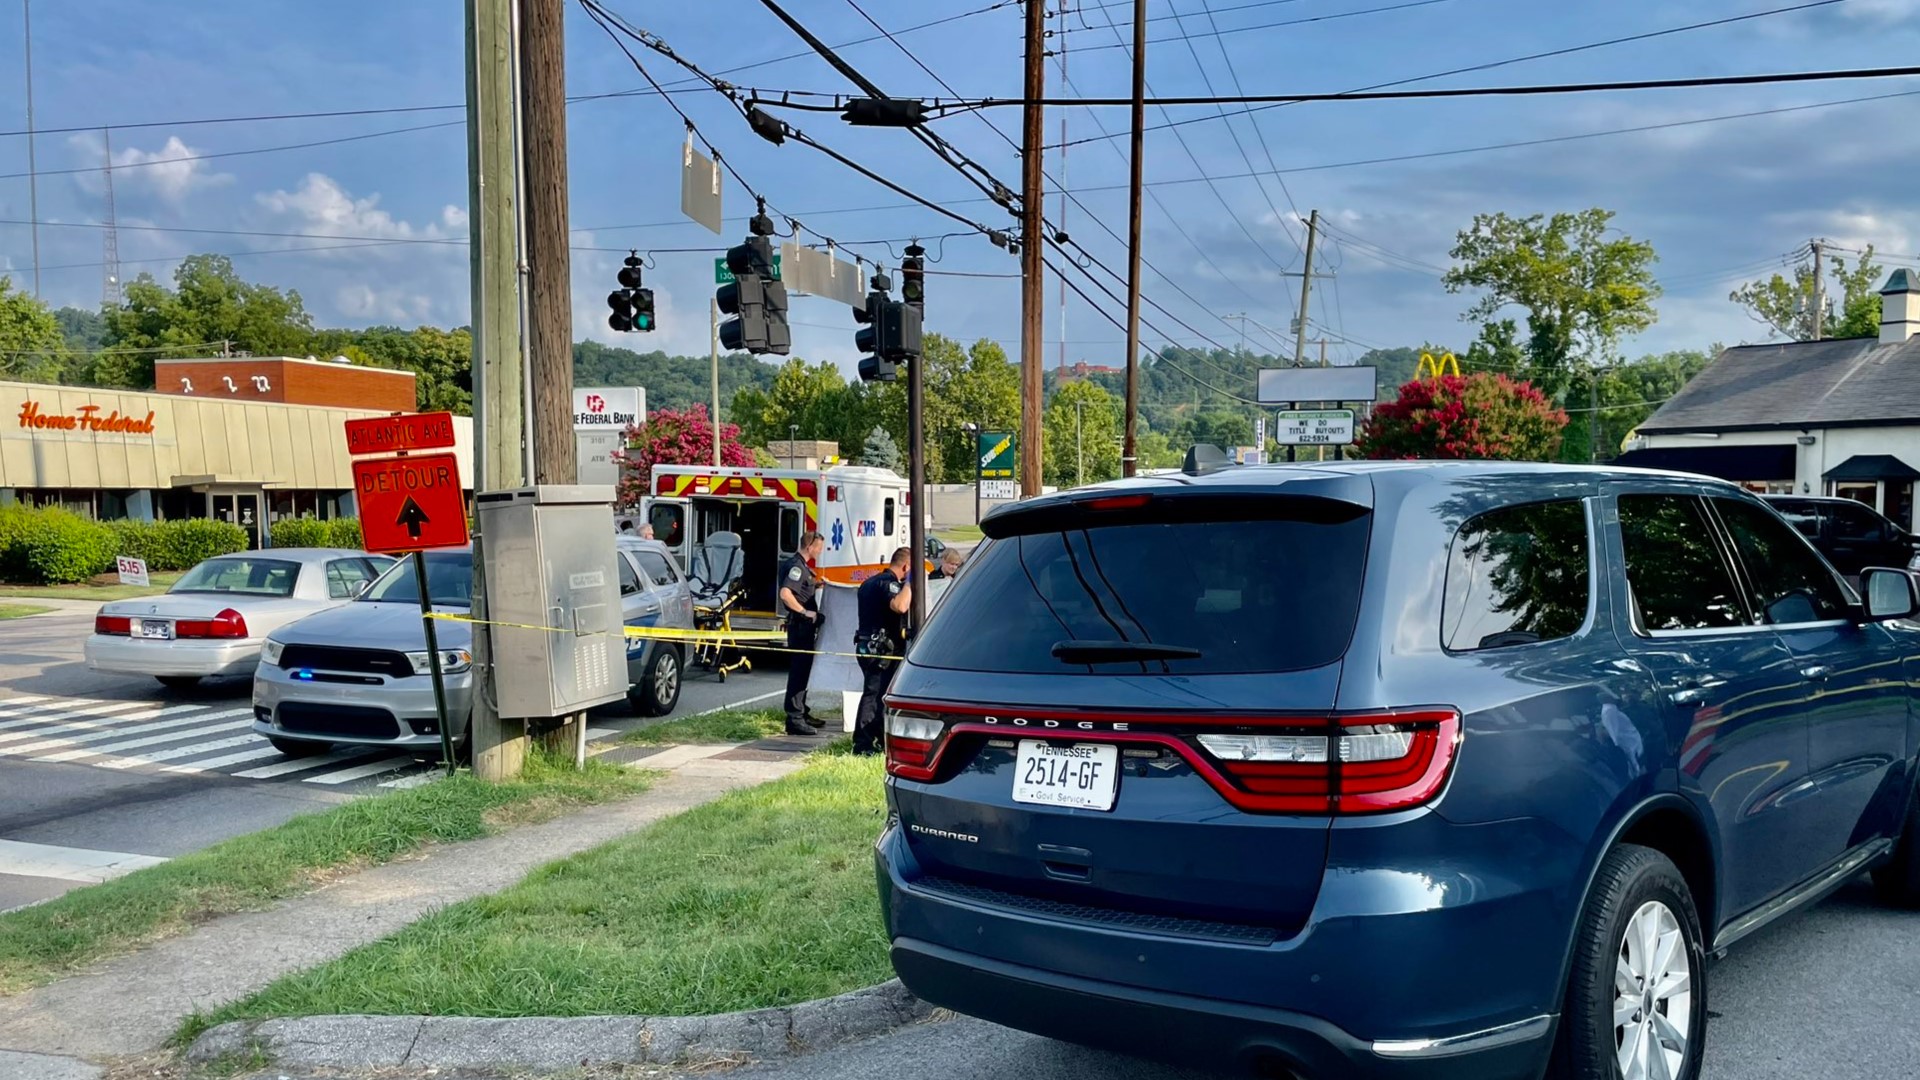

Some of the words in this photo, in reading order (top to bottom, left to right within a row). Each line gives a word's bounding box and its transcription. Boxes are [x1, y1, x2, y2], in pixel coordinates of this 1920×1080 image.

[18, 401, 77, 430] Home
[76, 405, 155, 434] Federal
[581, 412, 613, 425] FEDERAL
[613, 411, 636, 425] BANK
[1299, 419, 1309, 427] WE
[1318, 419, 1328, 427] DO
[350, 424, 416, 446] ATLANTIC
[423, 420, 451, 440] AVE
[1289, 427, 1306, 435] TITLE
[1315, 427, 1345, 435] BUYOUTS
[981, 433, 1012, 468] SUBWAY
[361, 466, 451, 493] DETOUR
[857, 520, 876, 537] AMR
[985, 716, 1129, 731] DODGE
[1040, 744, 1092, 759] TENNESSEE
[1024, 756, 1102, 790] 2514-GF
[1057, 792, 1085, 804] Service
[911, 824, 979, 843] DURANGO
